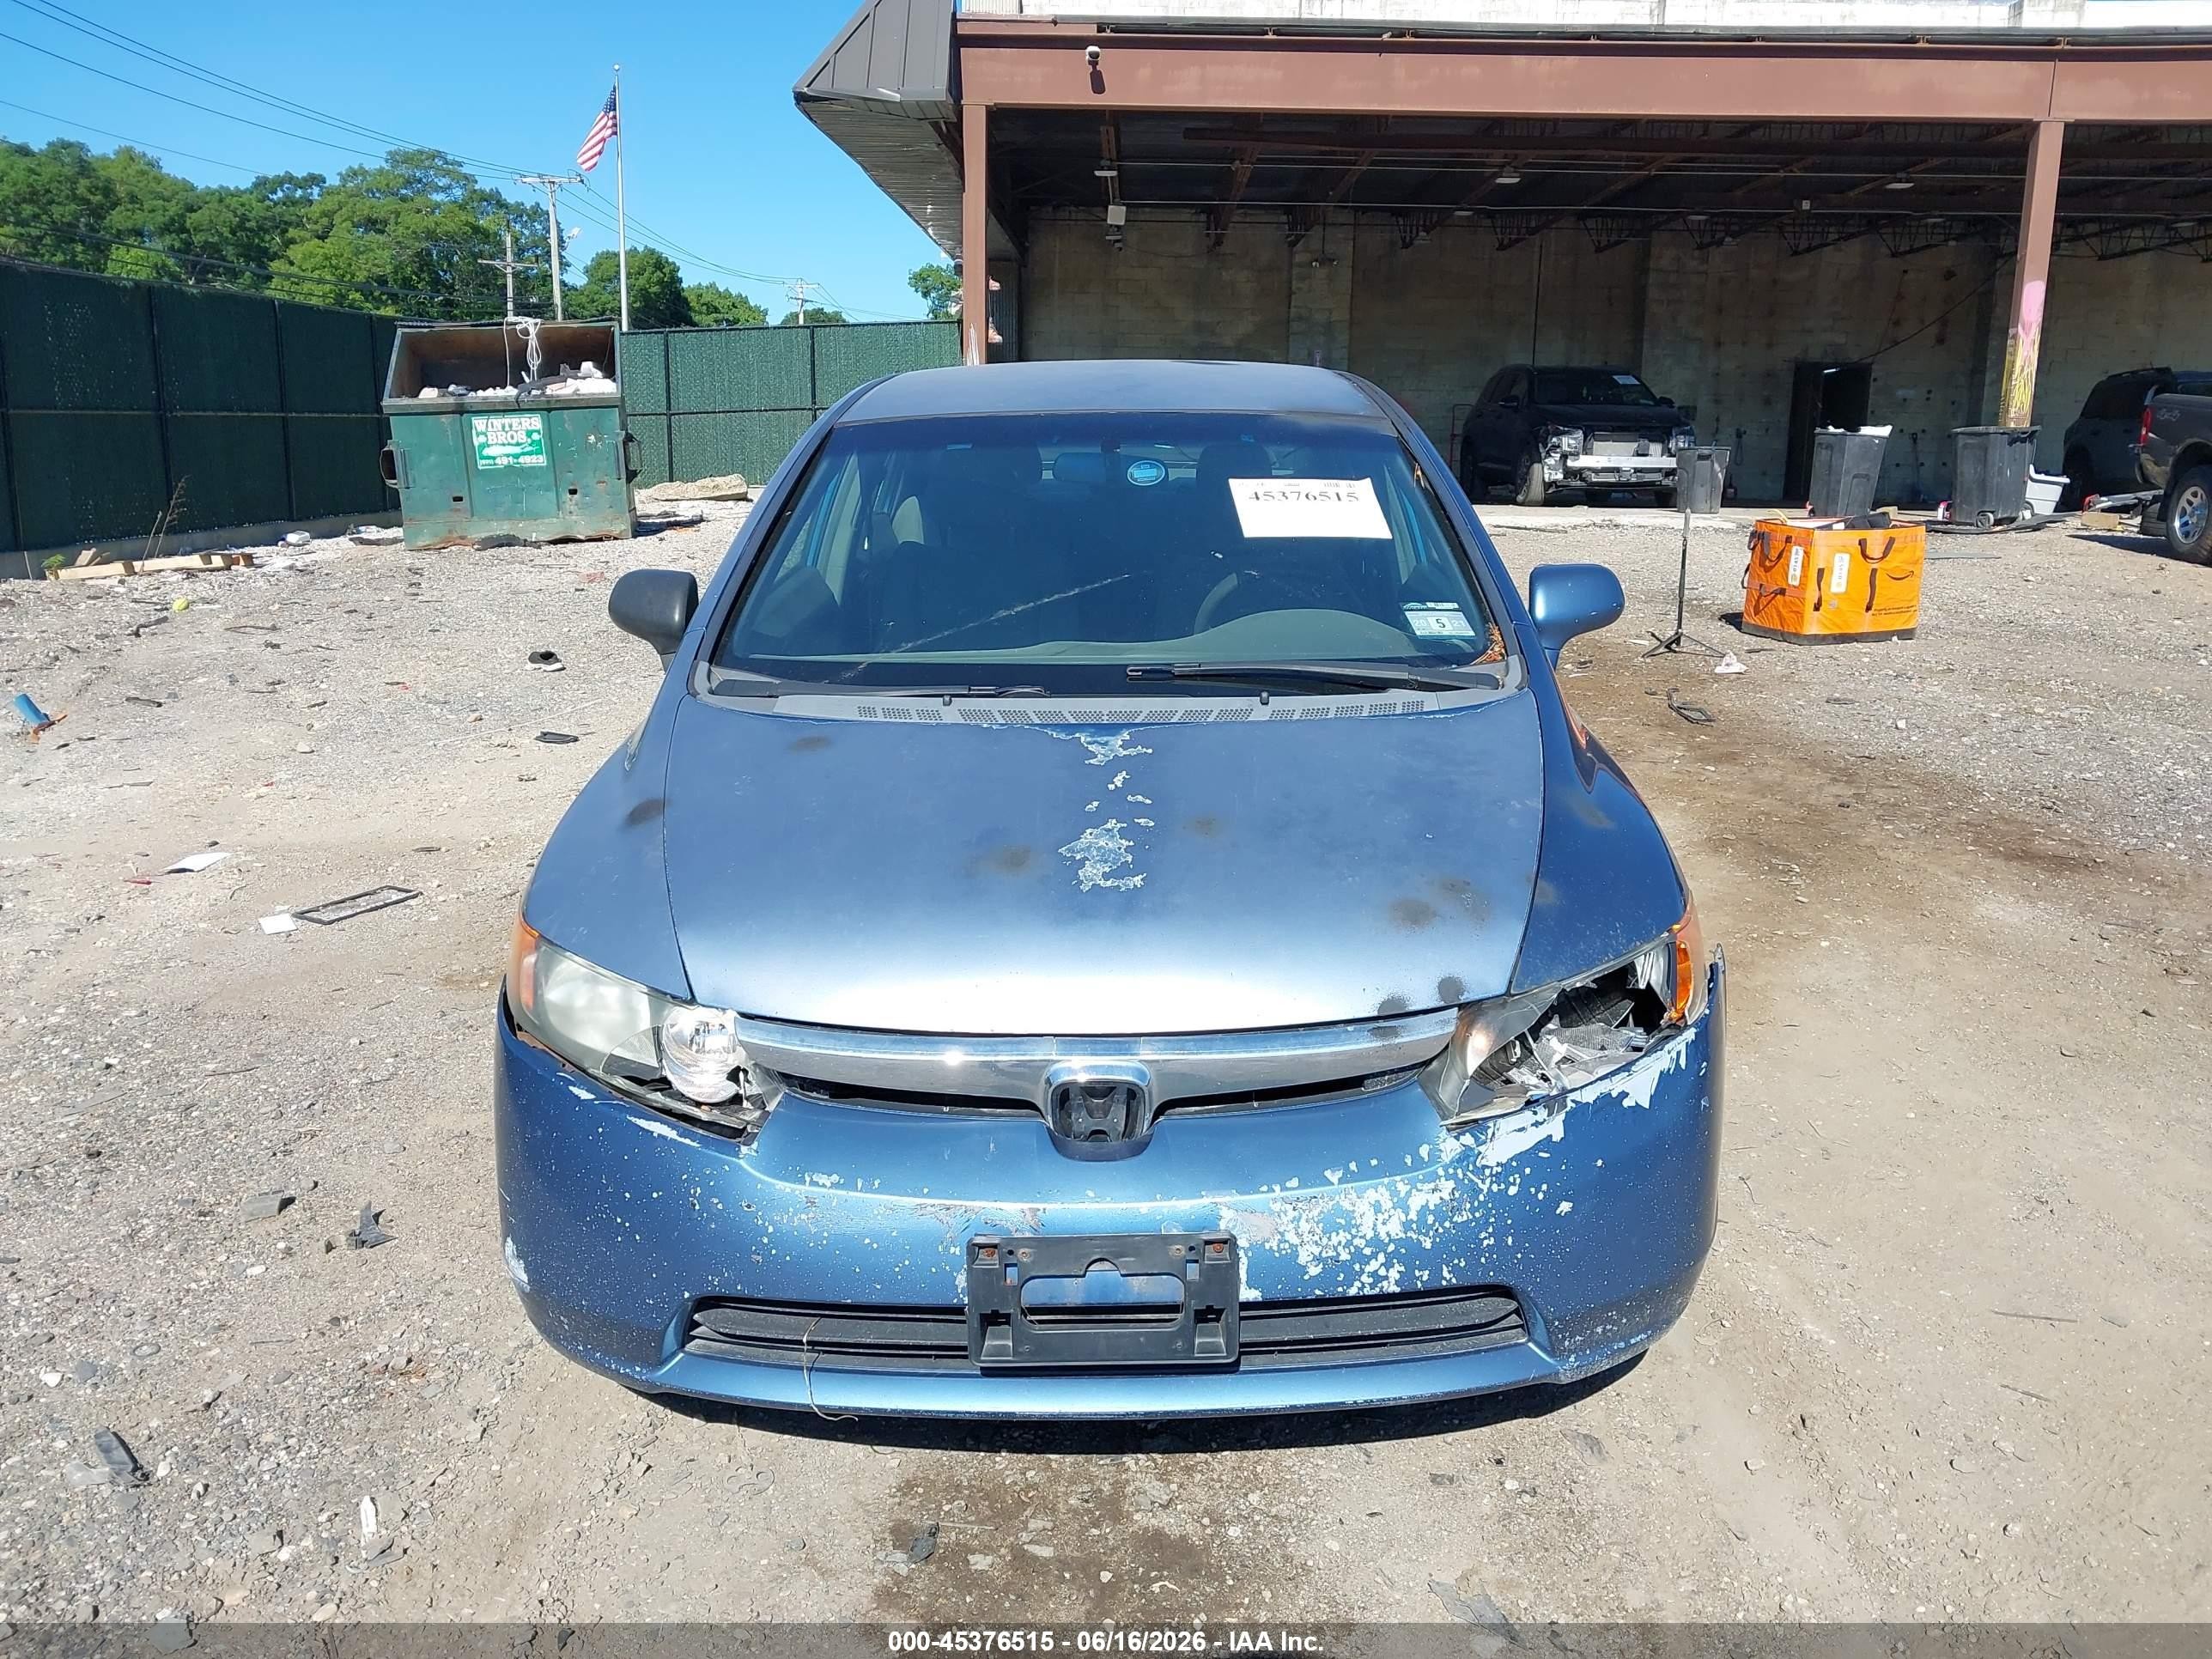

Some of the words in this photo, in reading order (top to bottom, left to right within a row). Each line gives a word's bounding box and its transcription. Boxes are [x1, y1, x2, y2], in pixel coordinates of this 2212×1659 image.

[474, 417, 540, 432] WINTERS
[487, 431, 532, 444] BROS.
[1249, 490, 1359, 502] 45376515
[1436, 618, 1446, 629] 5
